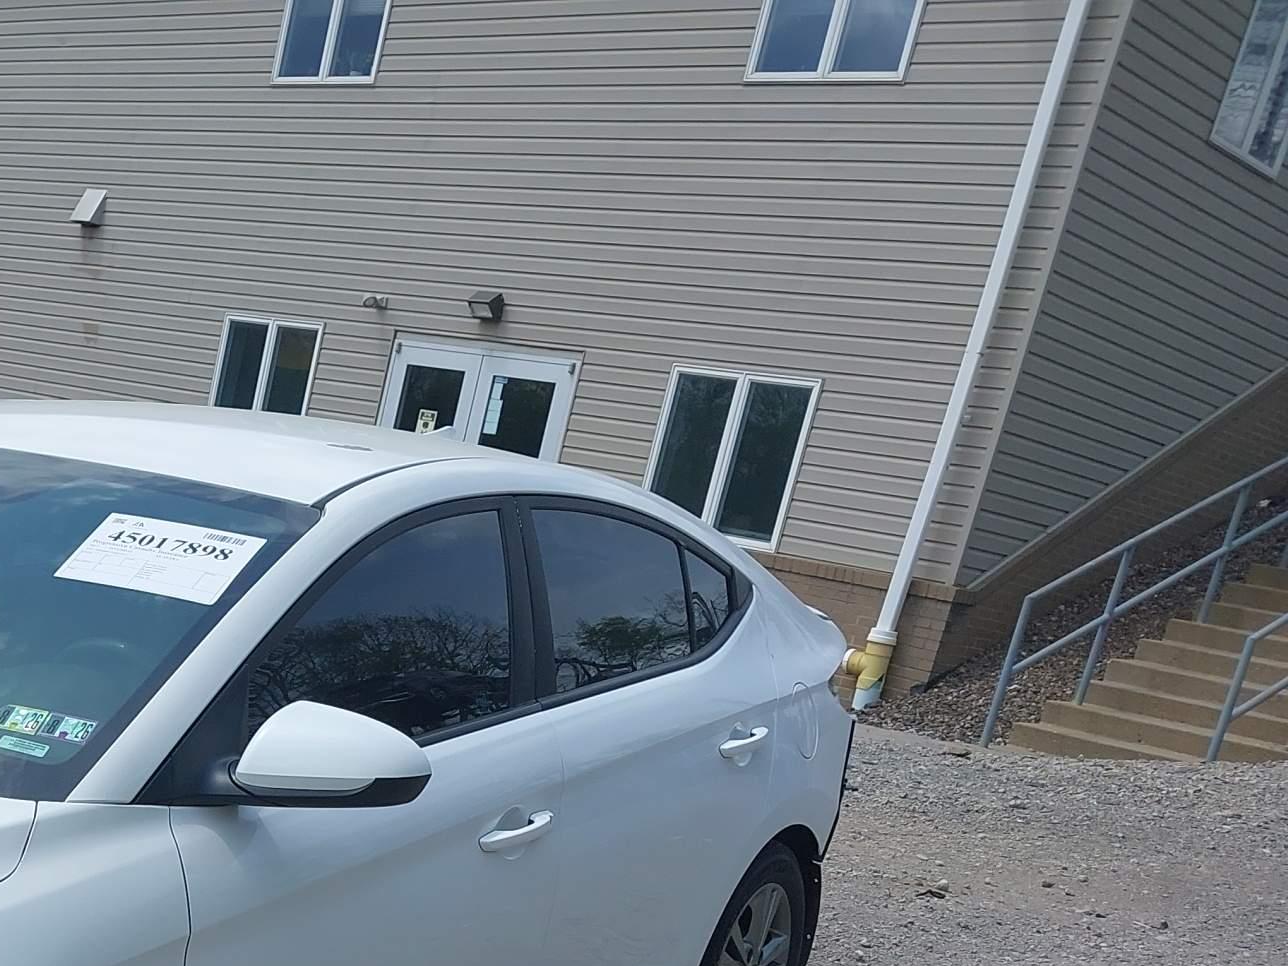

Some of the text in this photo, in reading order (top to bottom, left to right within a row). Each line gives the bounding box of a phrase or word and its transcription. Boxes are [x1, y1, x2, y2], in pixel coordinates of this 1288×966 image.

[108, 530, 233, 561] 45017898
[24, 712, 44, 730] 26
[74, 722, 94, 740] 26
